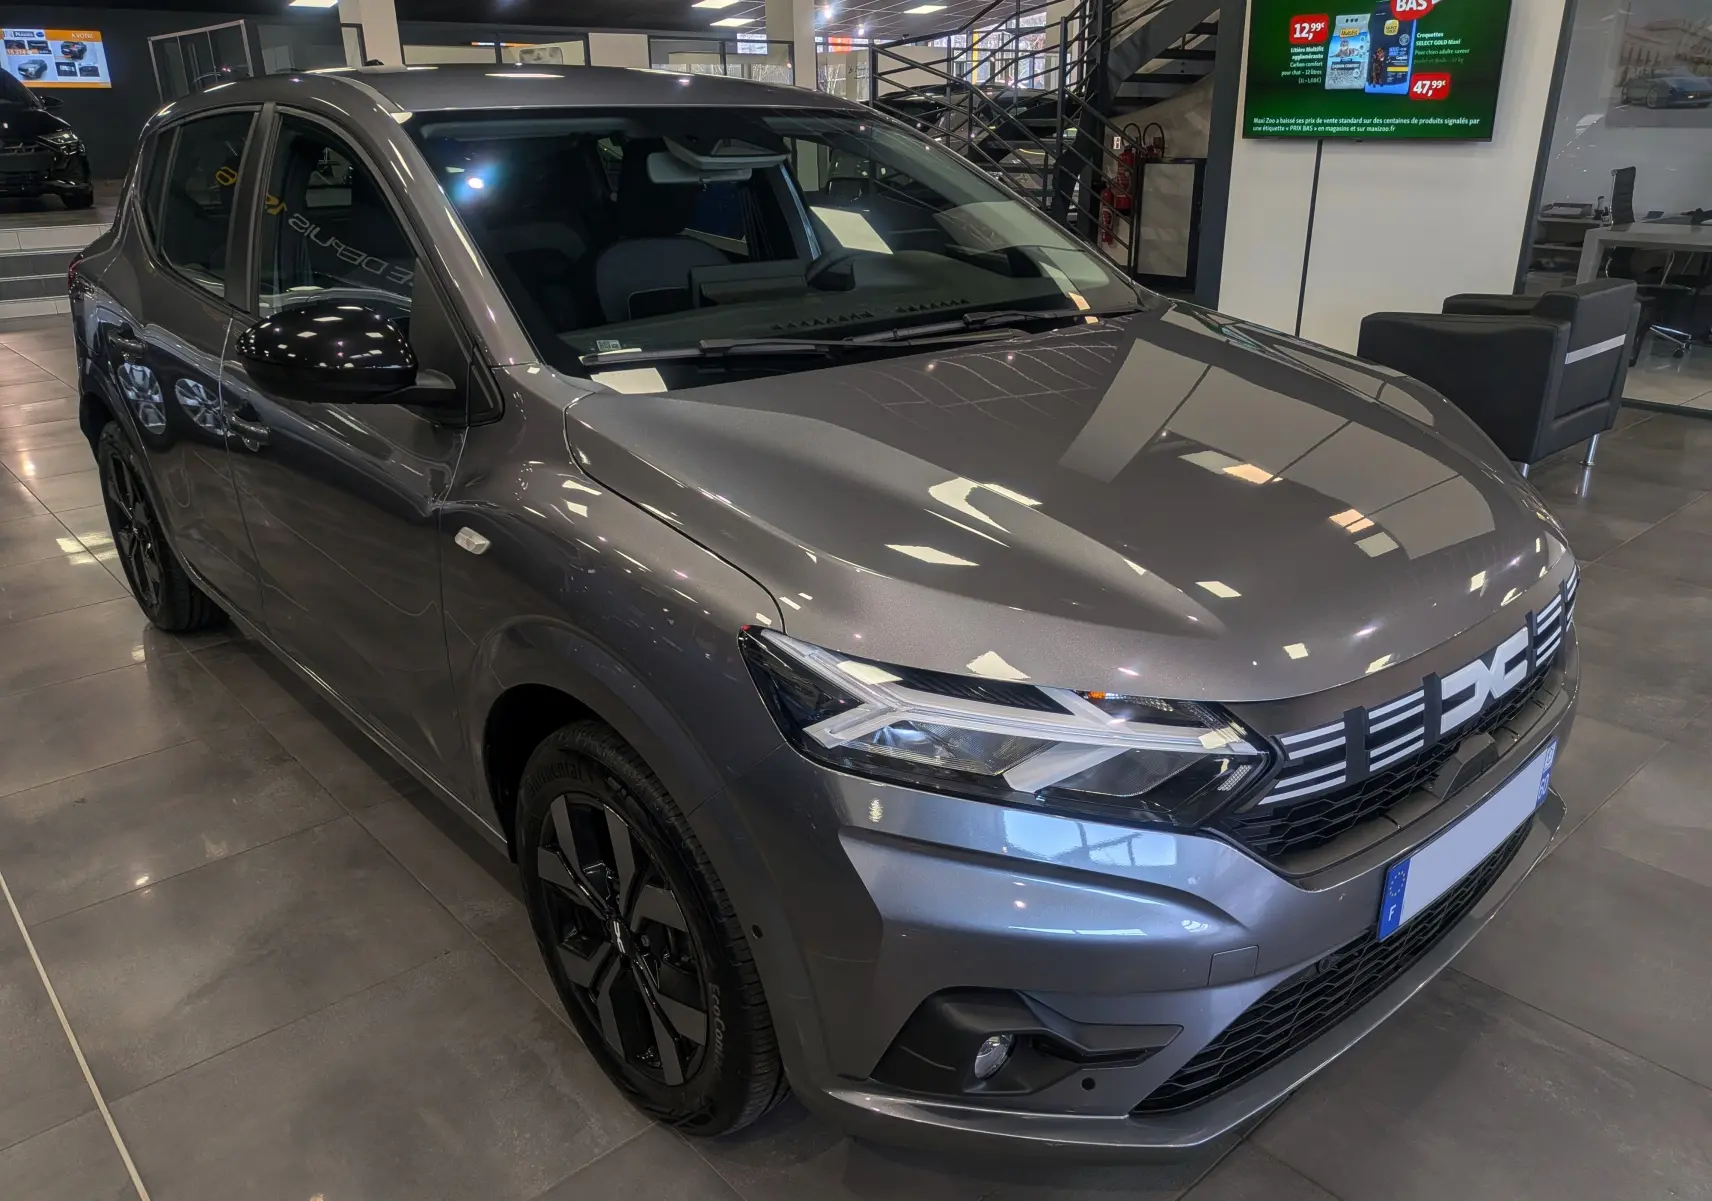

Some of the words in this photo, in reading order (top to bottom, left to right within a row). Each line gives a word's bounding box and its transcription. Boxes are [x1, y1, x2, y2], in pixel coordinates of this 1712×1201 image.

[1396, 0, 1428, 11] BAS
[1413, 80, 1446, 97] 47,99€
[1419, 117, 1444, 125] produits
[1444, 117, 1468, 126] signalés
[1388, 904, 1397, 921] F
